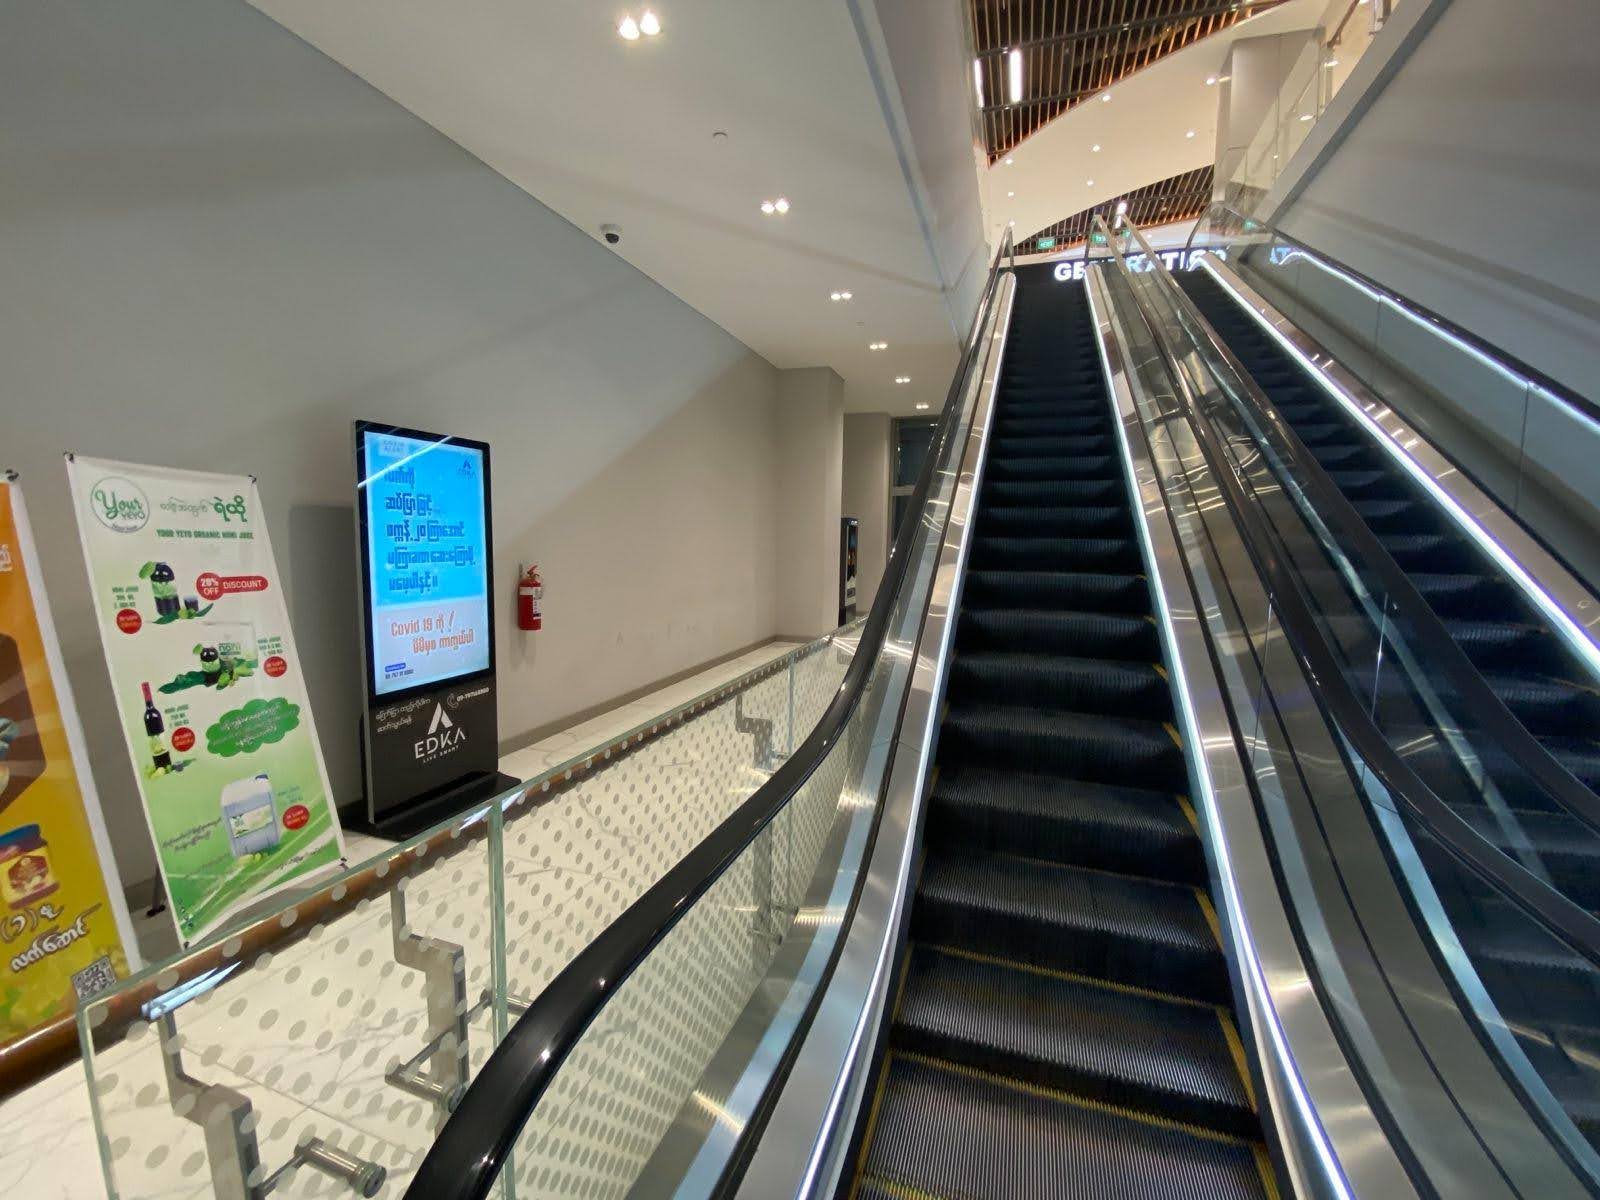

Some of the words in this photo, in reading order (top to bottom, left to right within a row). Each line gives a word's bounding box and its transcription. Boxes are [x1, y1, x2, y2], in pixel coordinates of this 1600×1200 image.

[94, 489, 142, 520] Your
[203, 587, 219, 596] OFF
[223, 579, 263, 589] DISCOUNT
[391, 620, 420, 637] Covid
[423, 617, 433, 632] 19
[414, 727, 466, 759] EDKA
